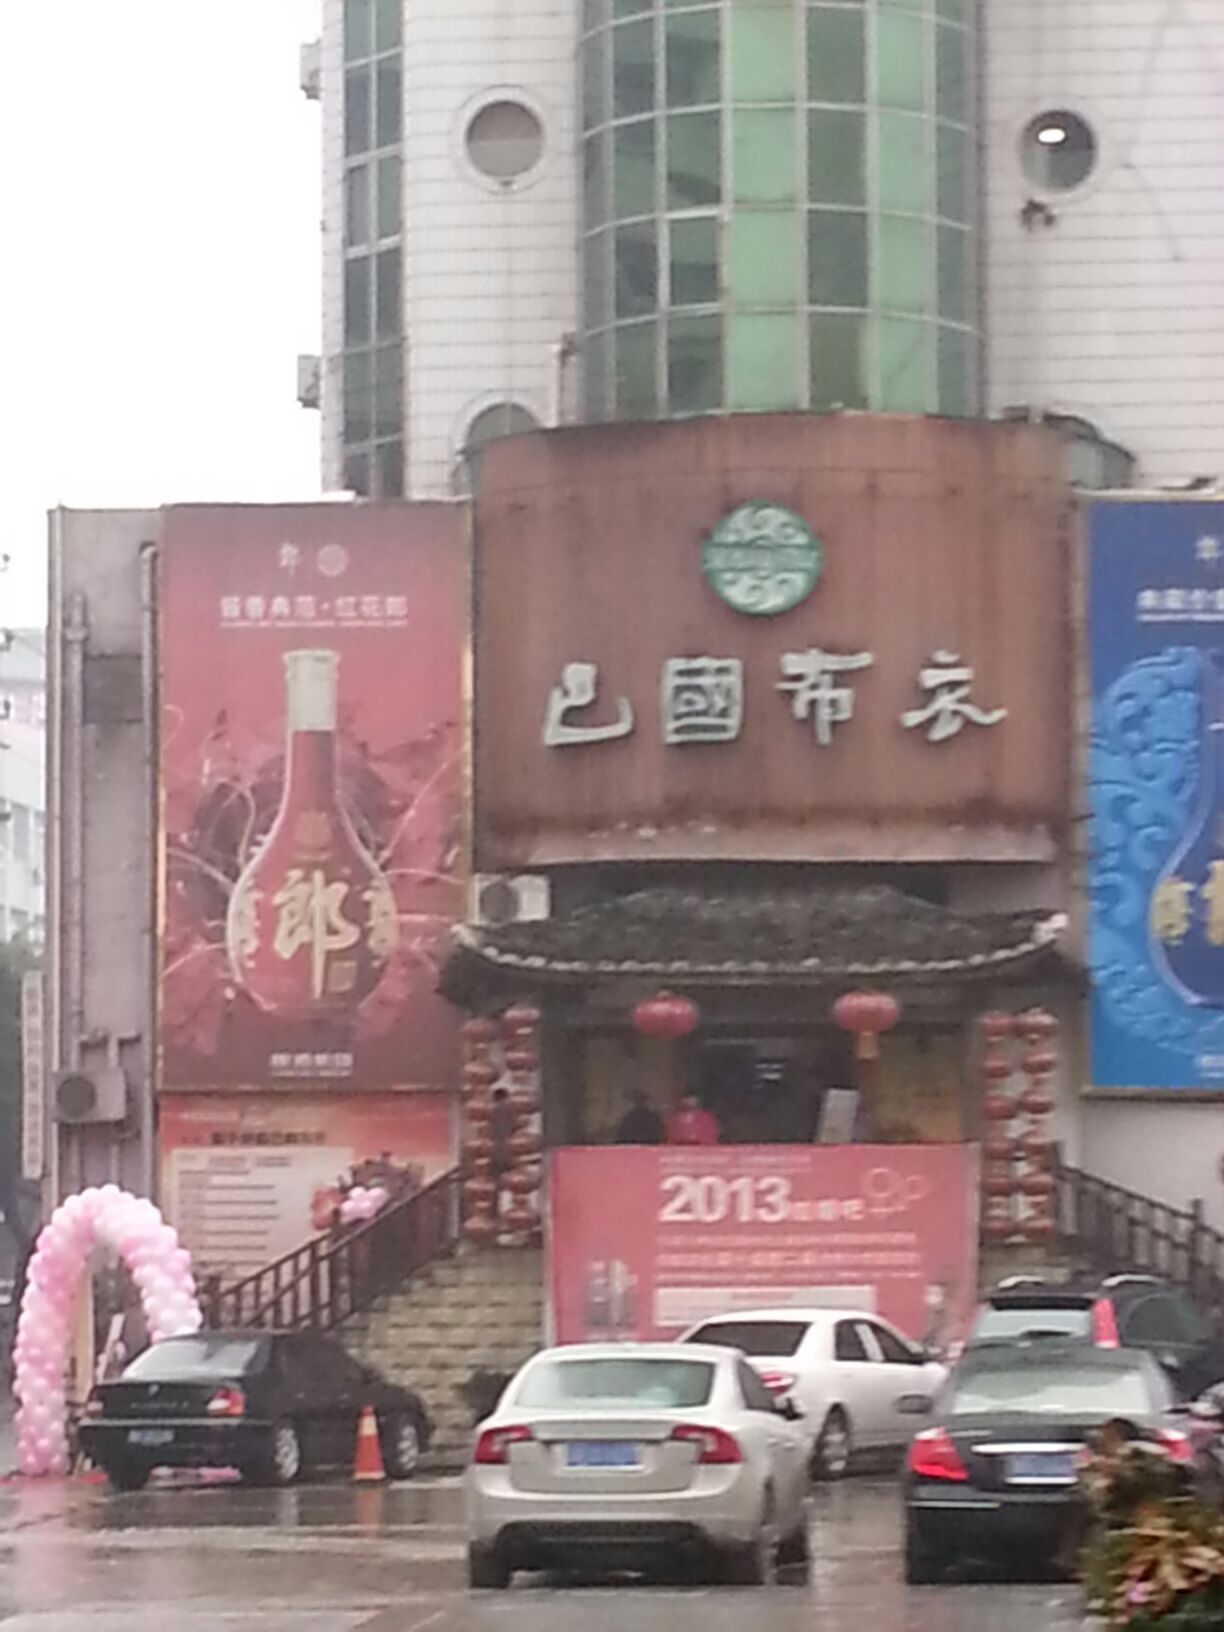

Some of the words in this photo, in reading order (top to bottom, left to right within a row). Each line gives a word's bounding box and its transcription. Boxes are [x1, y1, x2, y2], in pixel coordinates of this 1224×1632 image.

[543, 648, 1007, 746] 巴國布衣
[658, 1175, 792, 1223] 2013
